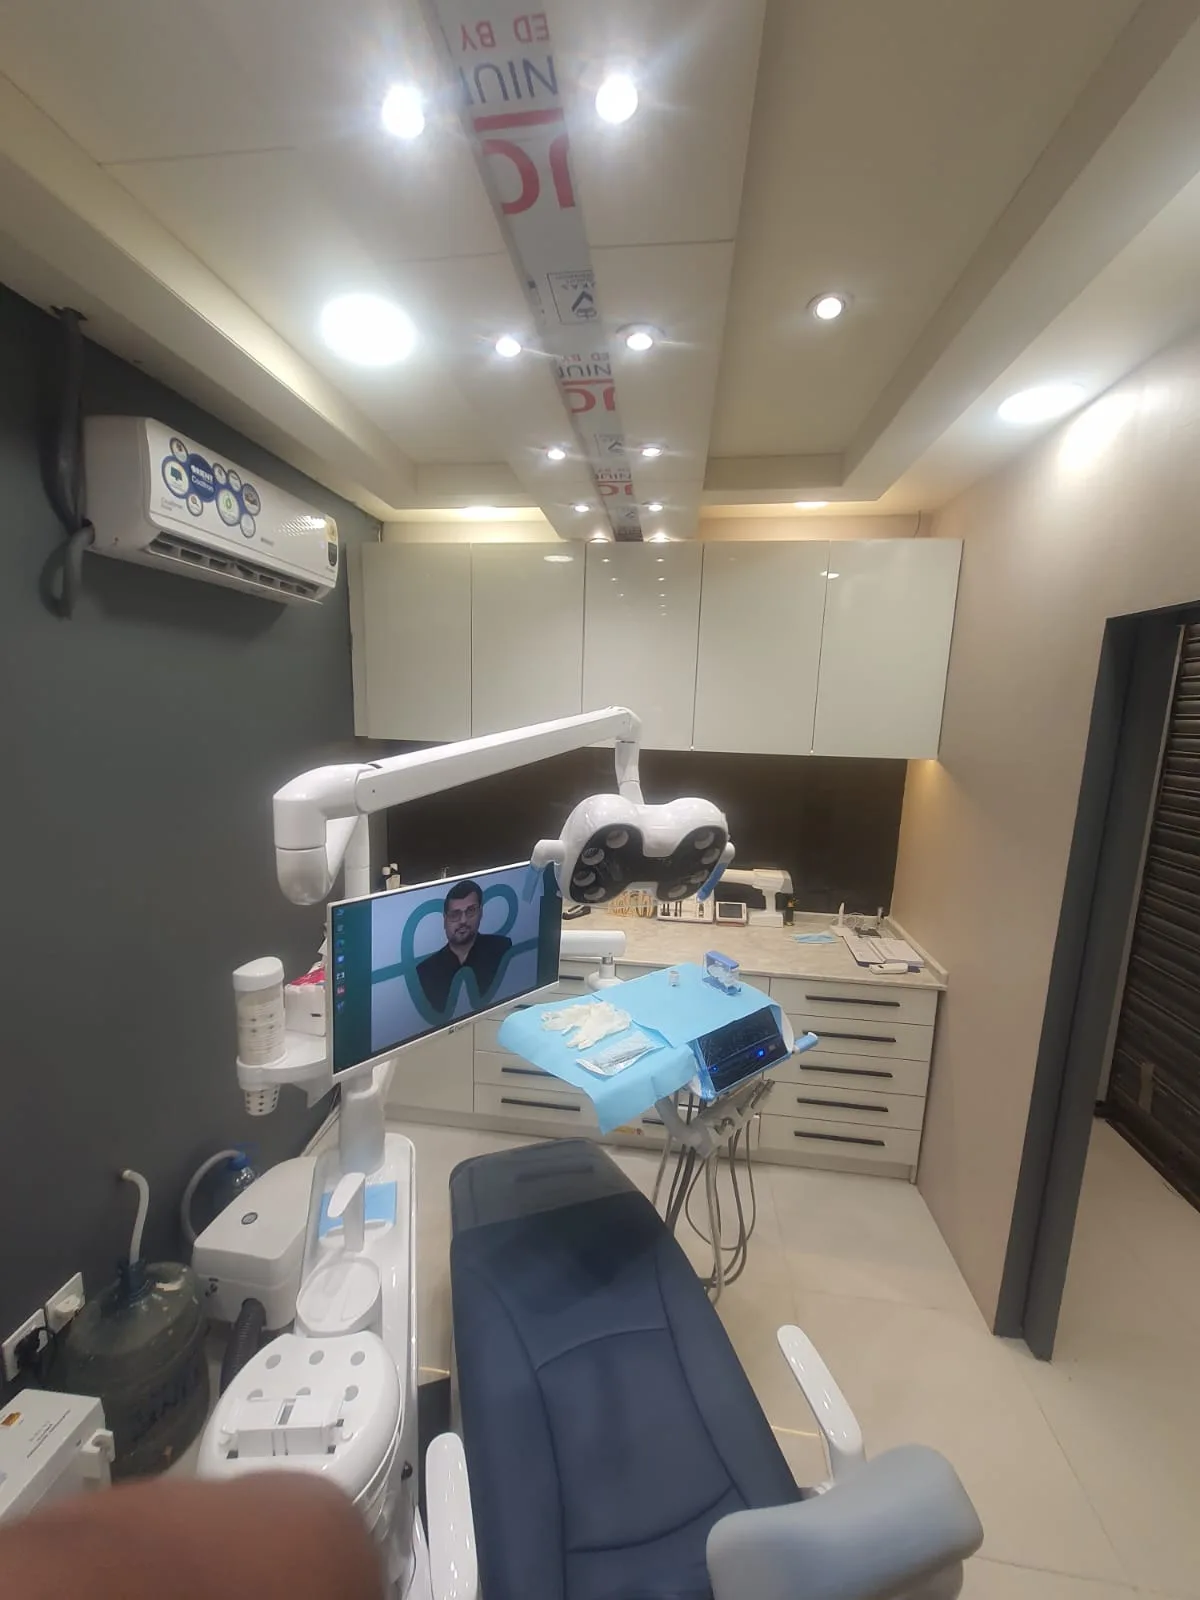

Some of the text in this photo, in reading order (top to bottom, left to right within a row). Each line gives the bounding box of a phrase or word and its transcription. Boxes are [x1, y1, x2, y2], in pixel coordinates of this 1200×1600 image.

[460, 13, 551, 51] ED BY
[459, 56, 558, 105] NIU
[558, 364, 612, 378] NIU
